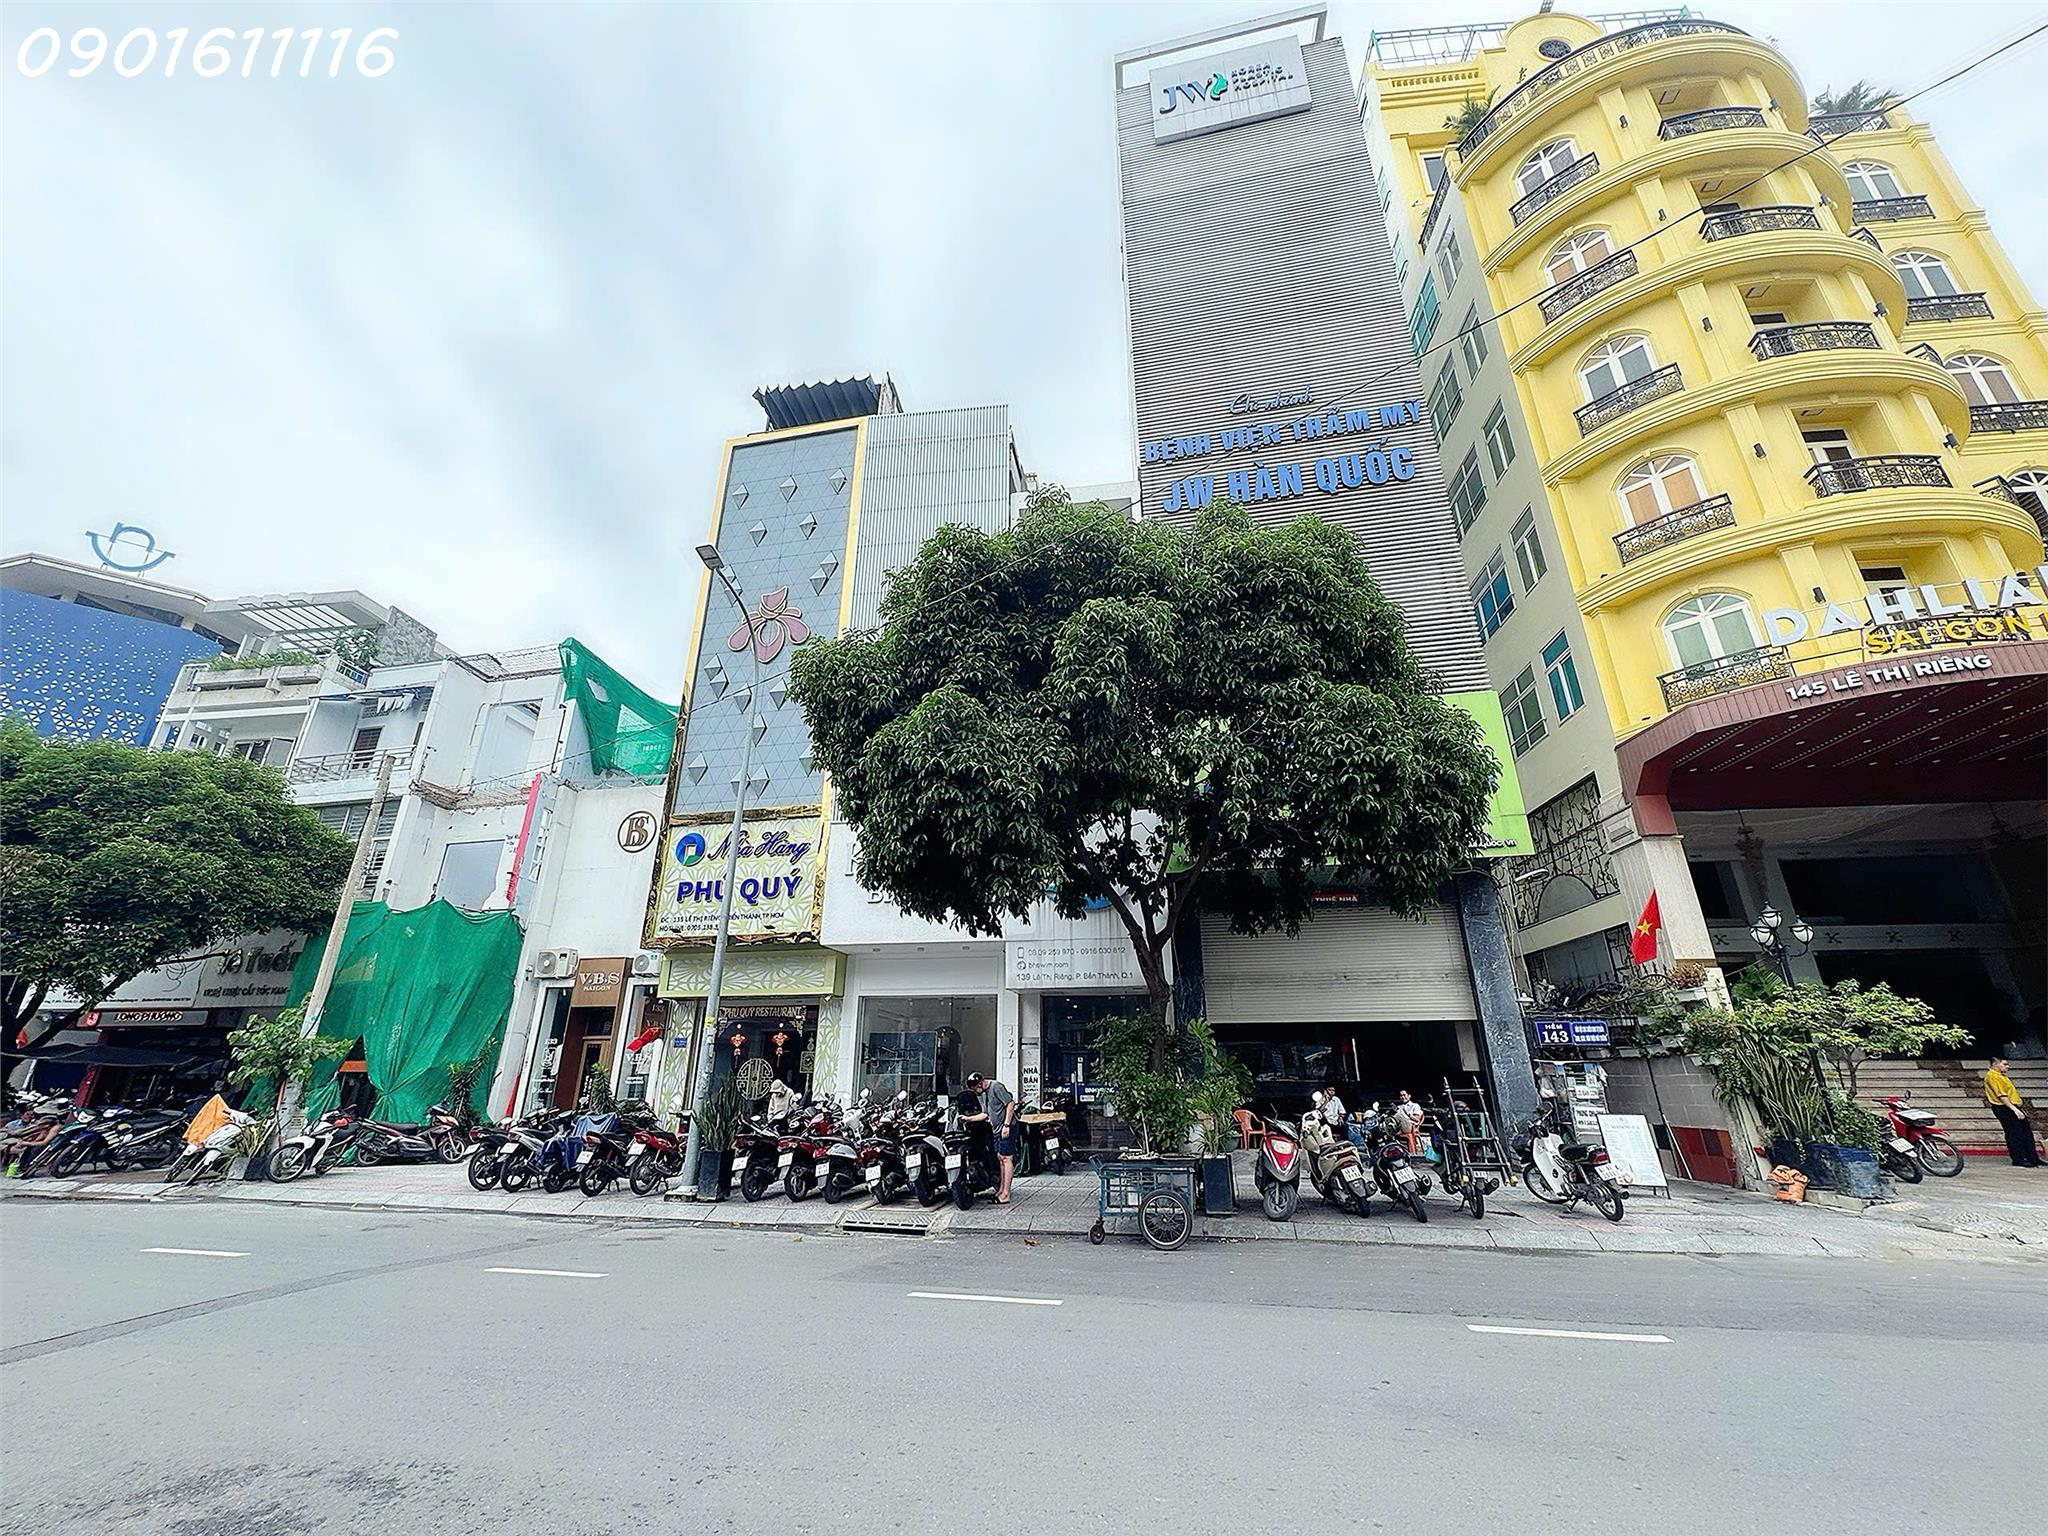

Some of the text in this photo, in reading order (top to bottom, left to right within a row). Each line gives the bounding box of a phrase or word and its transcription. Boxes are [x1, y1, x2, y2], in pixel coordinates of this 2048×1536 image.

[1160, 78, 1214, 114] JW
[1145, 432, 1212, 464] BỆNH
[1219, 421, 1282, 454] VIỆN
[1163, 437, 1417, 513] JW HÀN QUỐC
[1763, 574, 2043, 647] DAHLIA
[1786, 654, 1993, 701] 145 LÊ THỊ RIÊNG
[740, 868, 803, 906] QUÝ
[1017, 972, 1031, 981] 139
[1542, 1030, 1569, 1043] 143
[1023, 1066, 1038, 1074] NHÀ
[1023, 1076, 1039, 1084] BÁN
